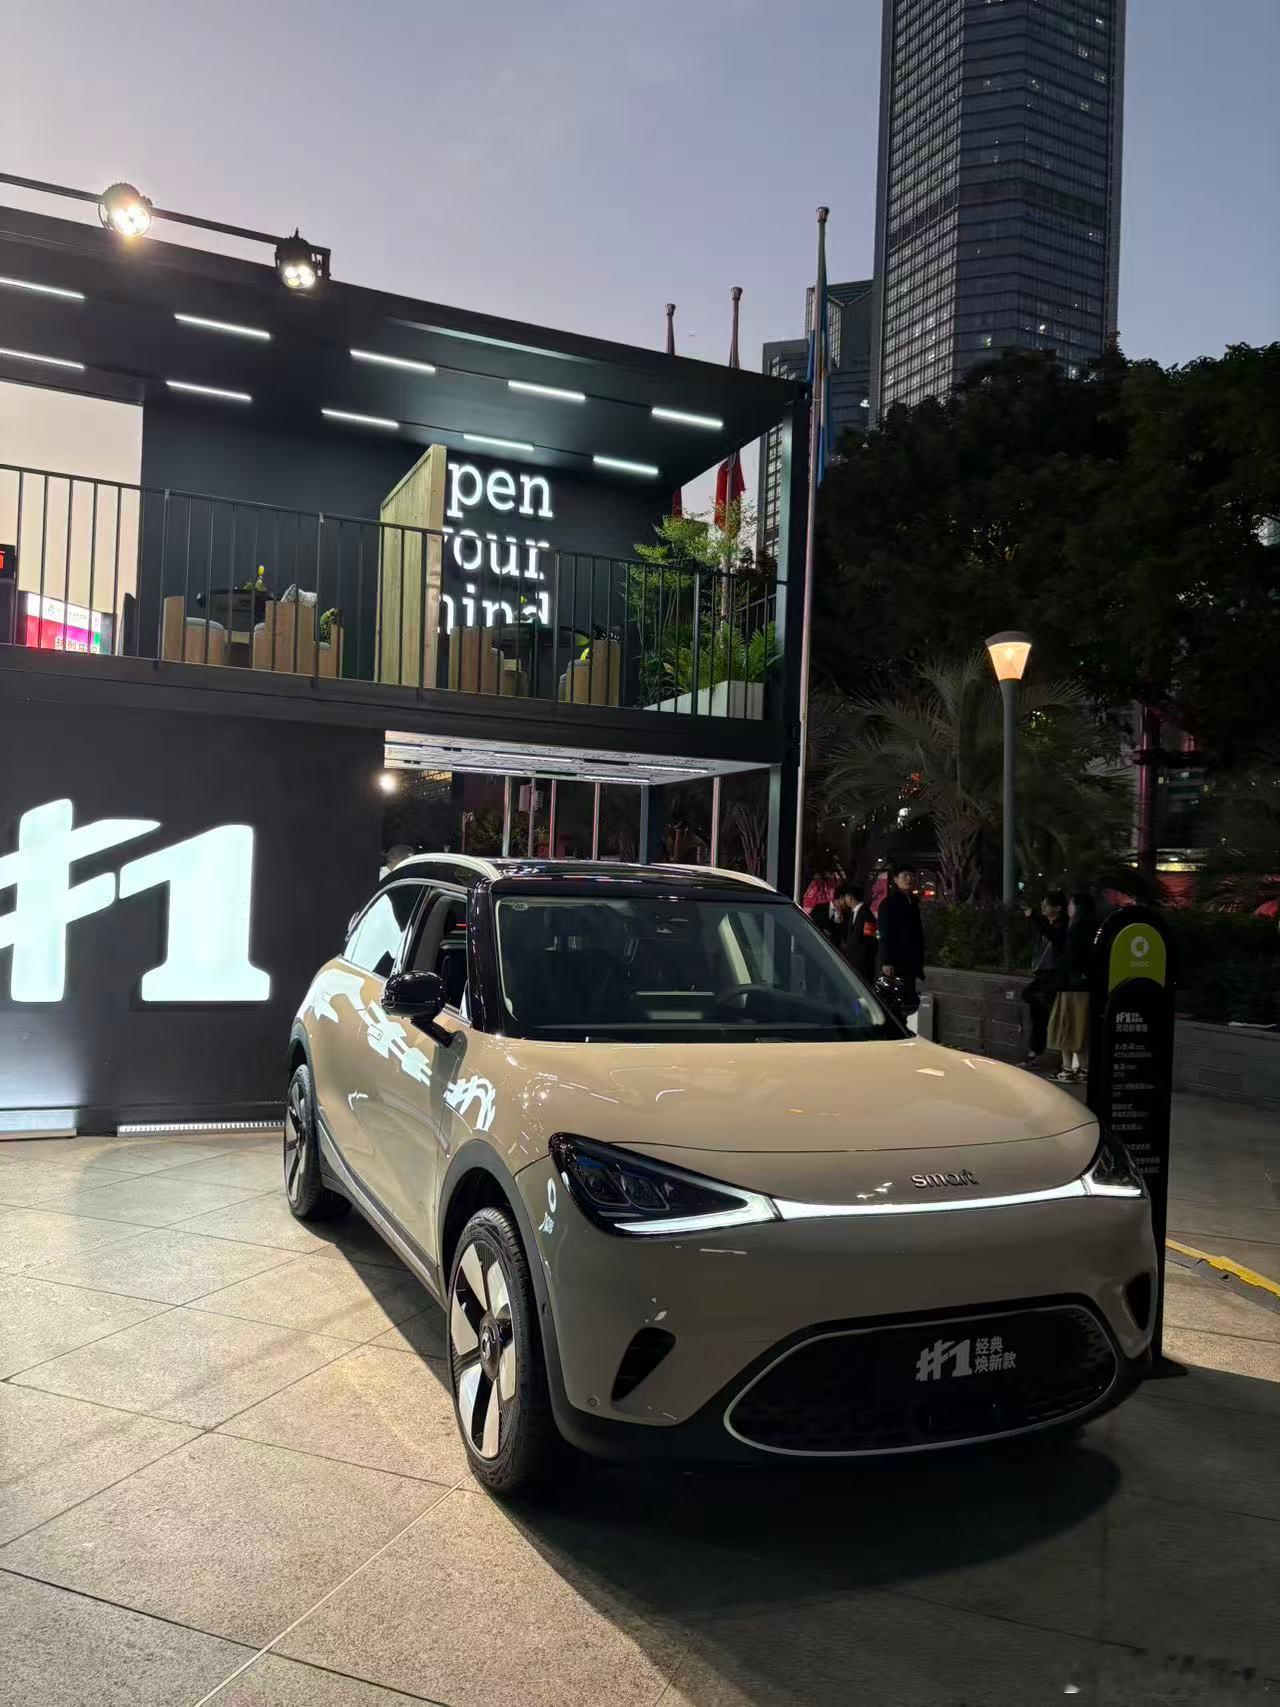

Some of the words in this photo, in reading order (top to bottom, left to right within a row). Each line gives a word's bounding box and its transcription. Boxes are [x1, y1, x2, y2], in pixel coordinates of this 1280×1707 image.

[447, 464, 553, 518] pen
[911, 1169, 979, 1188] smart
[976, 1336, 1003, 1355] 经典
[915, 1339, 972, 1381] #1
[974, 1351, 1016, 1373] 焕新款
